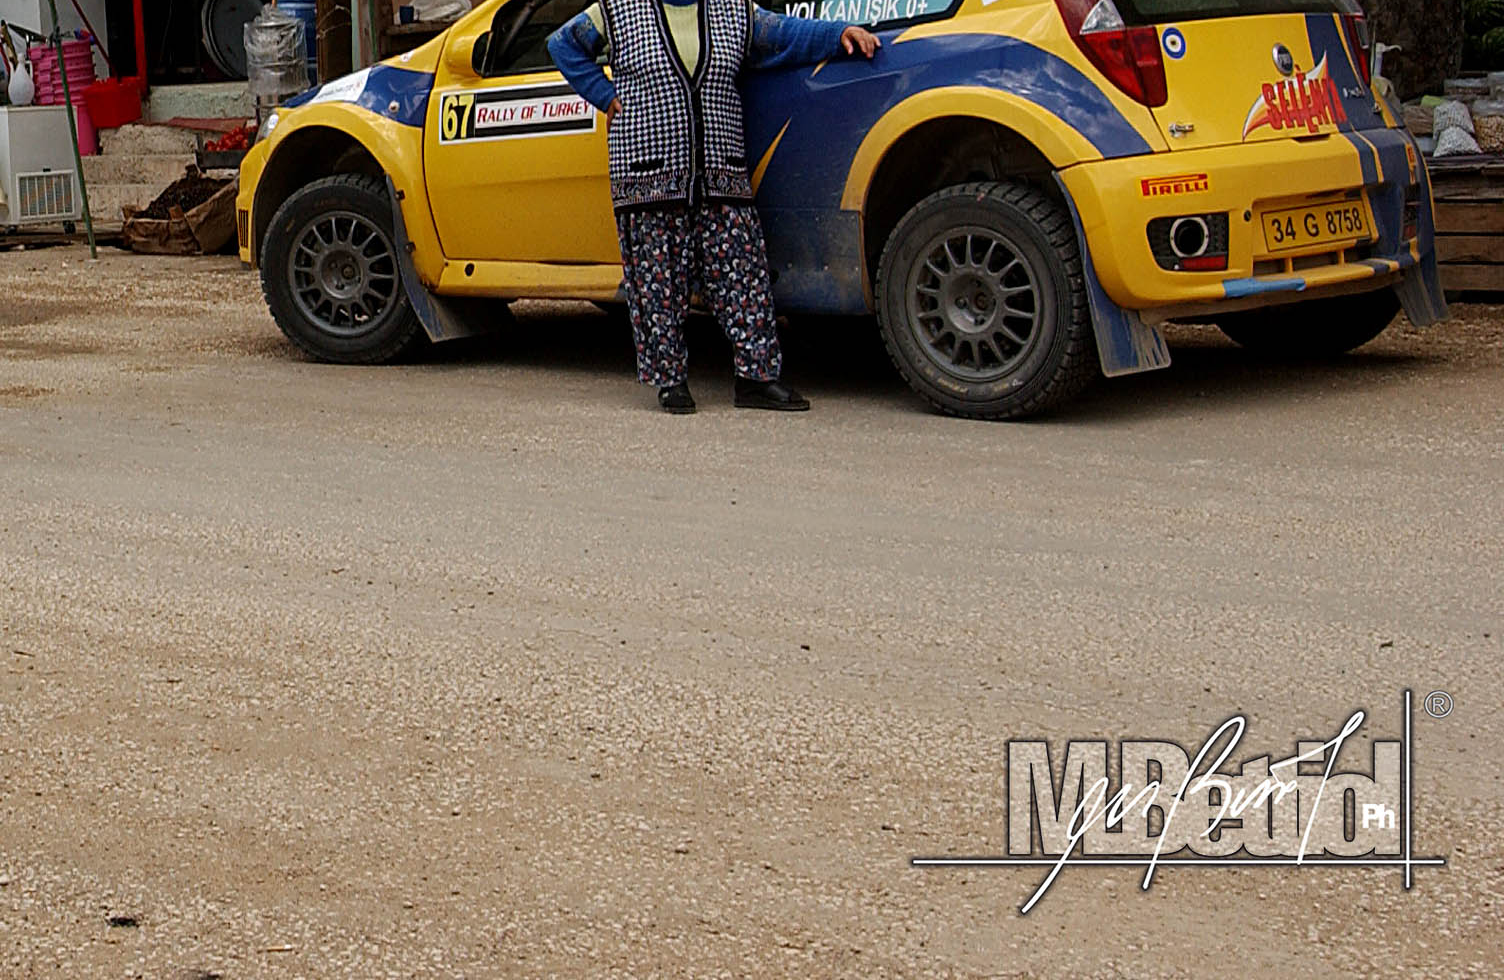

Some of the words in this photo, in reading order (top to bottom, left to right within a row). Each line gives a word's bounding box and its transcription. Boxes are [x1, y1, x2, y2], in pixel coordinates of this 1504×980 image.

[442, 93, 475, 140] 67
[477, 106, 517, 124] RALLY
[520, 104, 538, 120] OF
[541, 100, 591, 118] TURKEY
[1141, 173, 1209, 197] PIRELLI
[1271, 216, 1297, 243] 34
[1303, 213, 1320, 237] G
[1325, 207, 1363, 234] 8758
